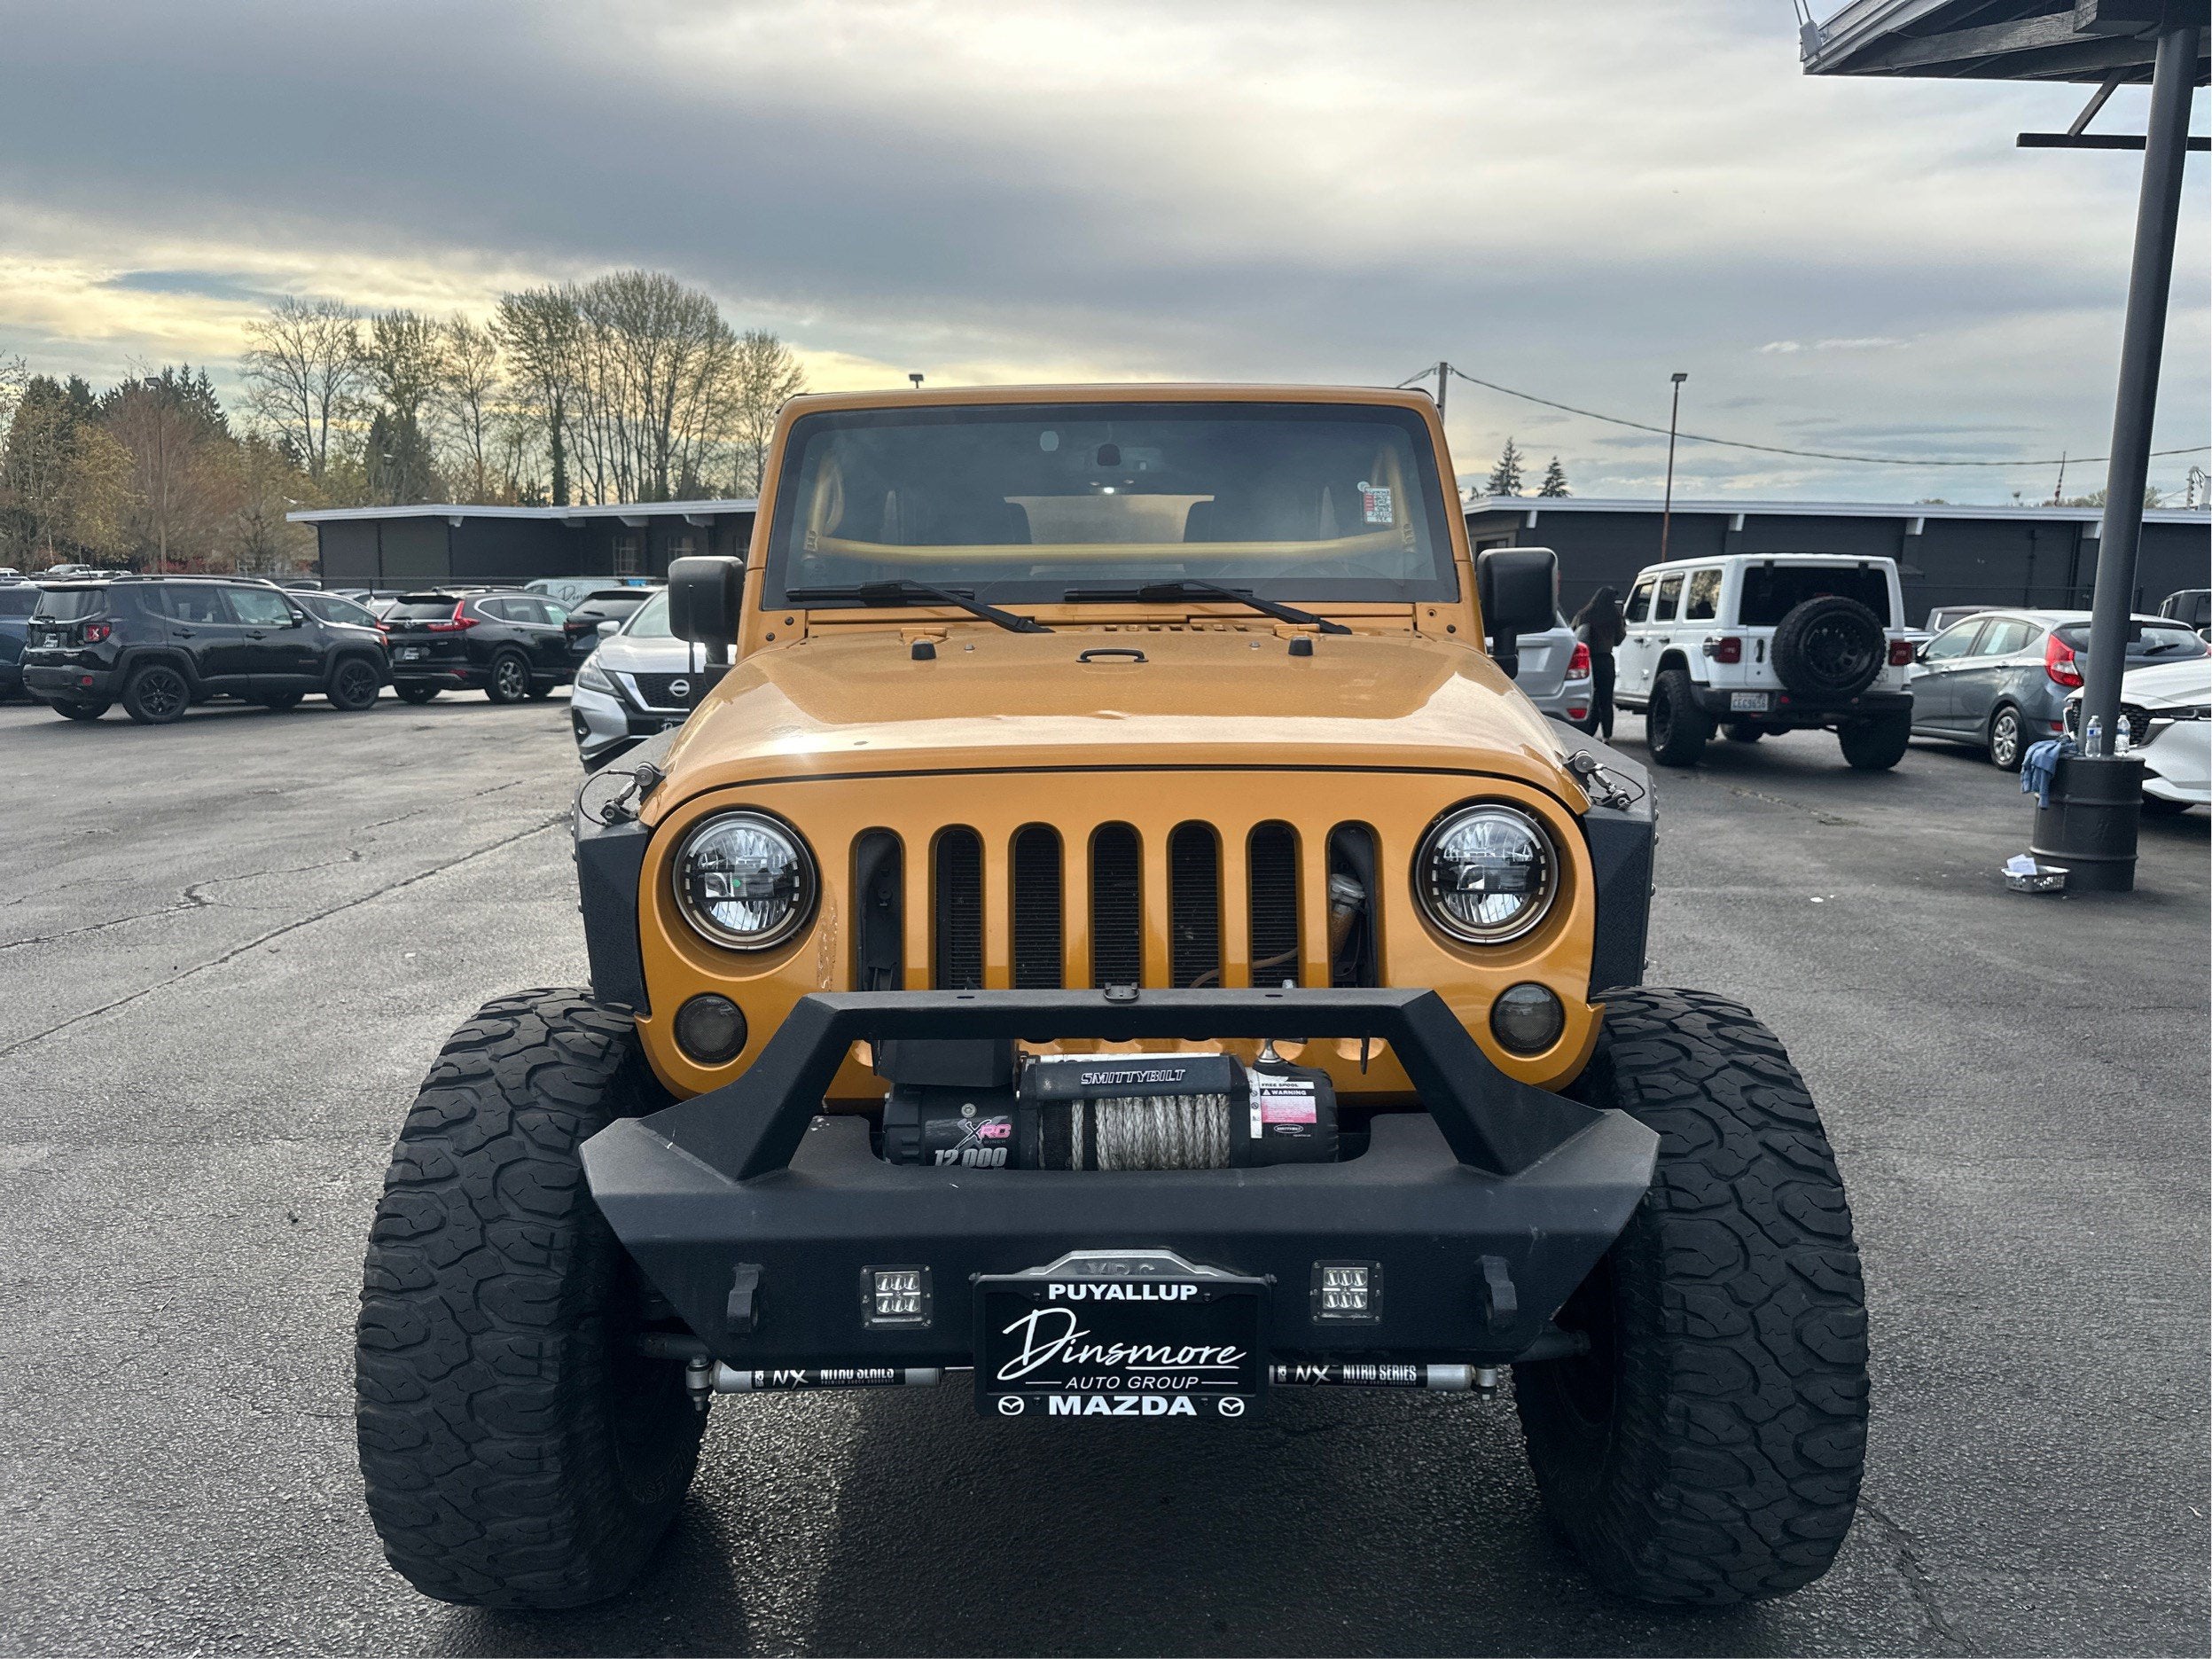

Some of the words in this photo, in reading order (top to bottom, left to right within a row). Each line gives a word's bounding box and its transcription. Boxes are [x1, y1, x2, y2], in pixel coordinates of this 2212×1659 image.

[1081, 1068, 1186, 1085] SMITTYBILT
[1048, 1284, 1198, 1301] PUYALLUP
[997, 1307, 1247, 1381] Dinsmore
[772, 1369, 809, 1390] NX
[1065, 1376, 1120, 1389] AUTO
[1127, 1376, 1199, 1389] GROUP
[1294, 1365, 1331, 1387] NX
[1343, 1365, 1376, 1381] NITRO
[1379, 1365, 1417, 1381] SERIES
[1048, 1395, 1198, 1416] MAZDA
